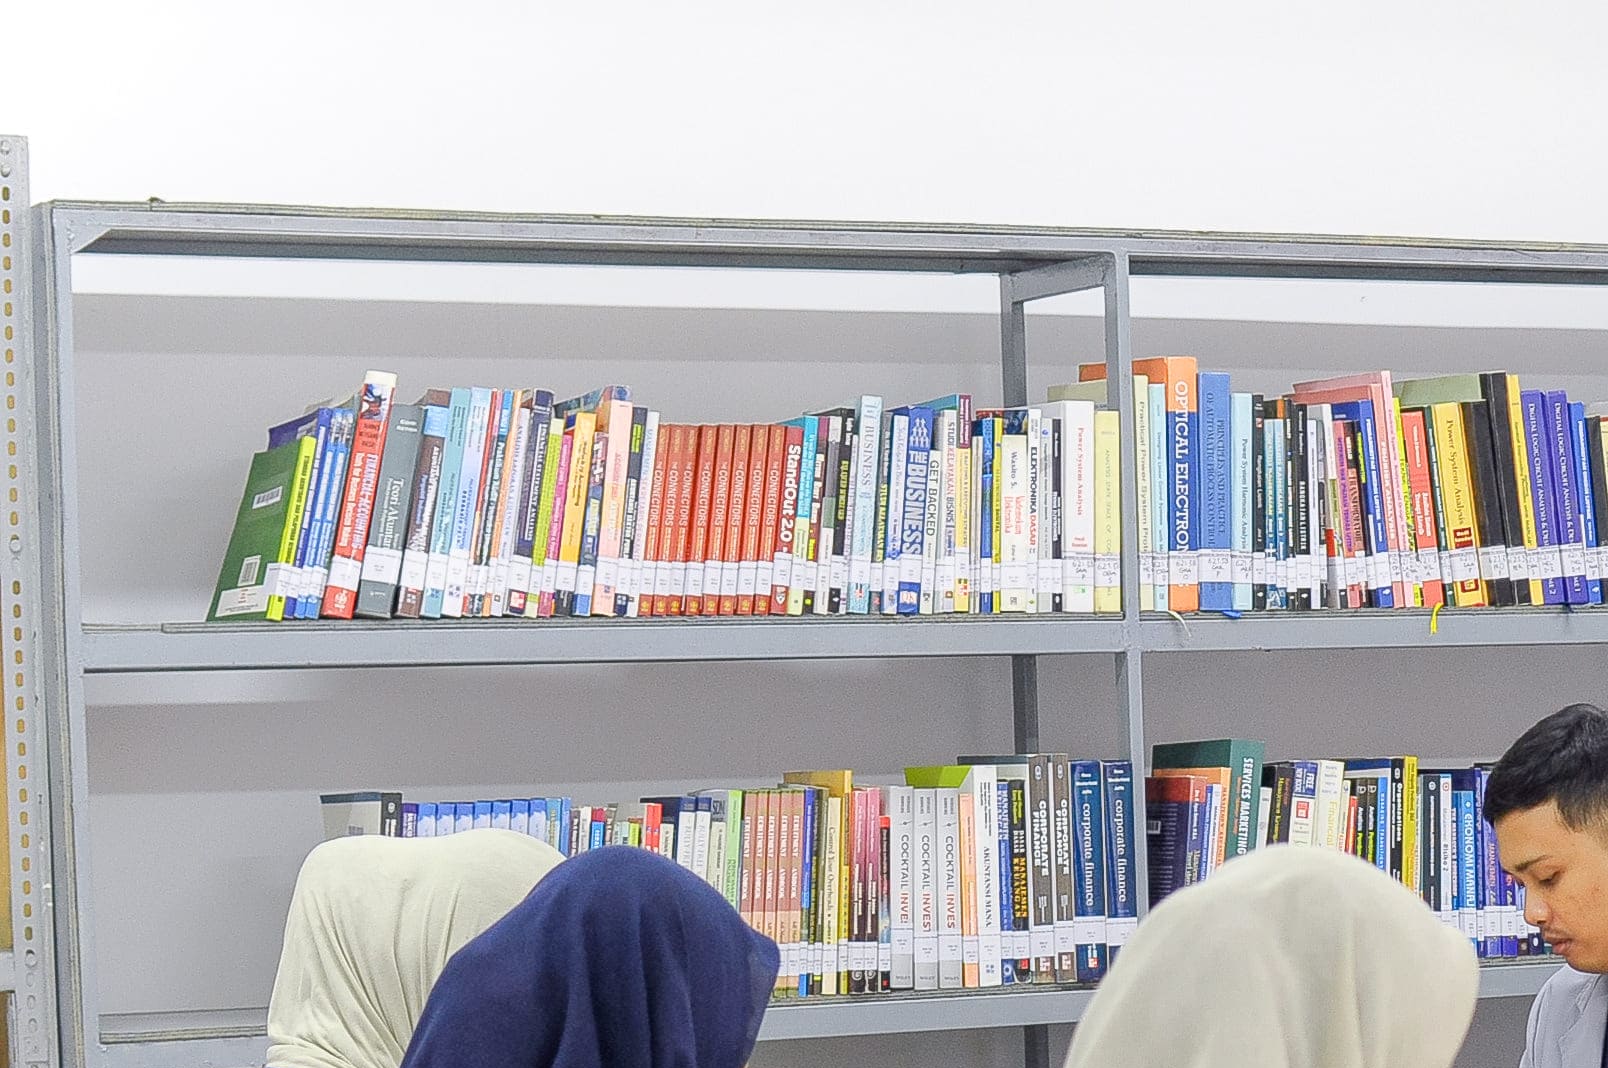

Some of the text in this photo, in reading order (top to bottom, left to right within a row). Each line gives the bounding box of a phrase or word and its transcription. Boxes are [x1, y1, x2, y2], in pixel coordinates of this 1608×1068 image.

[1139, 401, 1147, 446] Practical
[1174, 381, 1189, 459] OPTICAL
[525, 424, 548, 540] FINANCIAL STATEMENT ANALYSIS
[861, 425, 874, 486] BUSINESS
[946, 422, 955, 523] STUDI KELAYAKAN BISNIS
[1010, 451, 1018, 479] Wasito
[1029, 446, 1037, 514] ELEKTRONIKA
[1075, 427, 1085, 516] Power System Analysis
[1206, 406, 1215, 547] AUTOMATIC PROCESS CONTROL
[1216, 419, 1226, 534] PRINCIPLES AND PRACTICE
[1240, 458, 1248, 485] System
[1445, 419, 1465, 525] Power System Analysis
[1528, 403, 1547, 521] DIGITAL LOGIC CIRCUIT ANALYSIS
[1554, 402, 1571, 520] DIGITAL LOGIC CIRCUIT ANALYSIS
[391, 479, 404, 505] Teori
[649, 470, 662, 525] CONNECTORS
[666, 470, 680, 525] CONNECTORS
[679, 470, 692, 525] CONNECTORS
[697, 470, 710, 525] CONNECTORS
[714, 470, 727, 525] CONNECTORS
[731, 470, 744, 525] CONNECTORS
[748, 470, 762, 525] CONNECTORS
[765, 470, 778, 525] CONNECTORS
[781, 445, 801, 542] StandOut 2.0
[902, 452, 928, 554] THE BUSINESS
[926, 460, 939, 536] GET BACKED
[1141, 485, 1149, 525] System
[1236, 757, 1254, 855] SERVICES MARKETING
[1326, 800, 1337, 846] Financial
[828, 827, 836, 853] Control
[900, 834, 909, 889] COCKTAIL
[921, 835, 931, 890] COCKTAIL
[945, 836, 955, 890] COCKTAIL
[1032, 811, 1041, 867] FINANCE
[1039, 800, 1049, 876] CORPORATE
[1055, 809, 1063, 864] FINANCE
[1061, 799, 1069, 874] CORPORATE
[1082, 803, 1096, 906] corporate finance
[1113, 799, 1127, 902] corporate finance
[983, 846, 991, 898] AKUNTANSI
[1013, 857, 1021, 917] KEUANGAN
